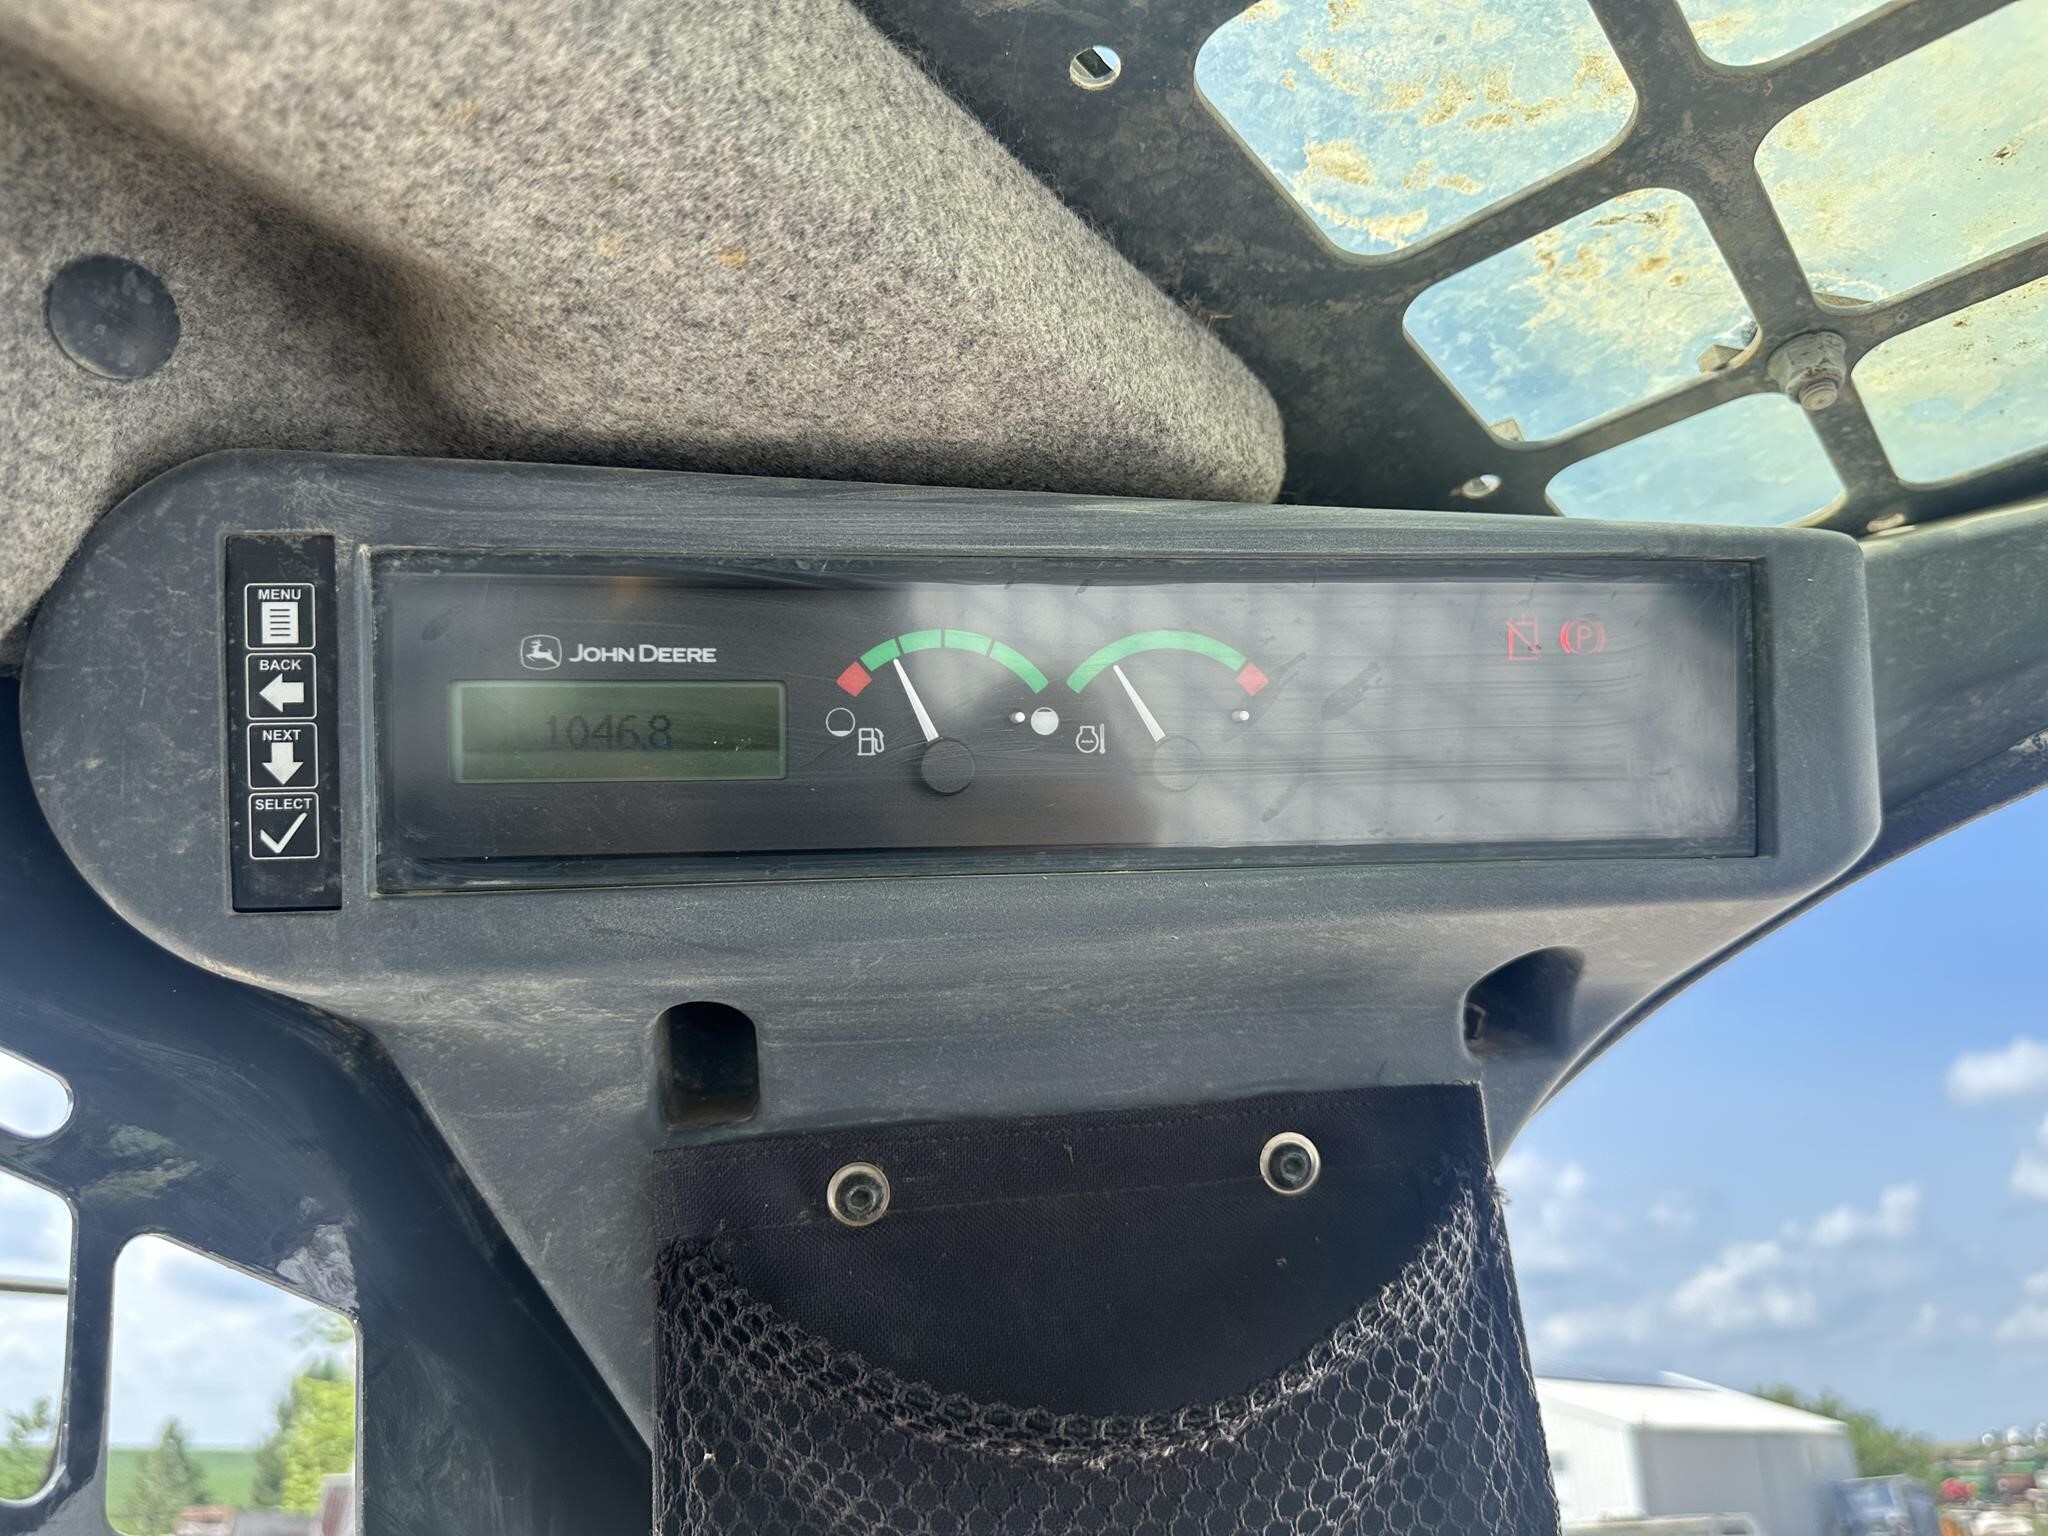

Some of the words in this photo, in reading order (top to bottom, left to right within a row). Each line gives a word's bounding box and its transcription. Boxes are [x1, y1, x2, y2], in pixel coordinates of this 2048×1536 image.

[258, 588, 302, 600] MENU
[569, 643, 635, 663] JOHN
[638, 644, 717, 663] DEERE
[259, 659, 302, 671] BACK
[262, 729, 302, 741] NEXT
[255, 797, 313, 810] SELECT
